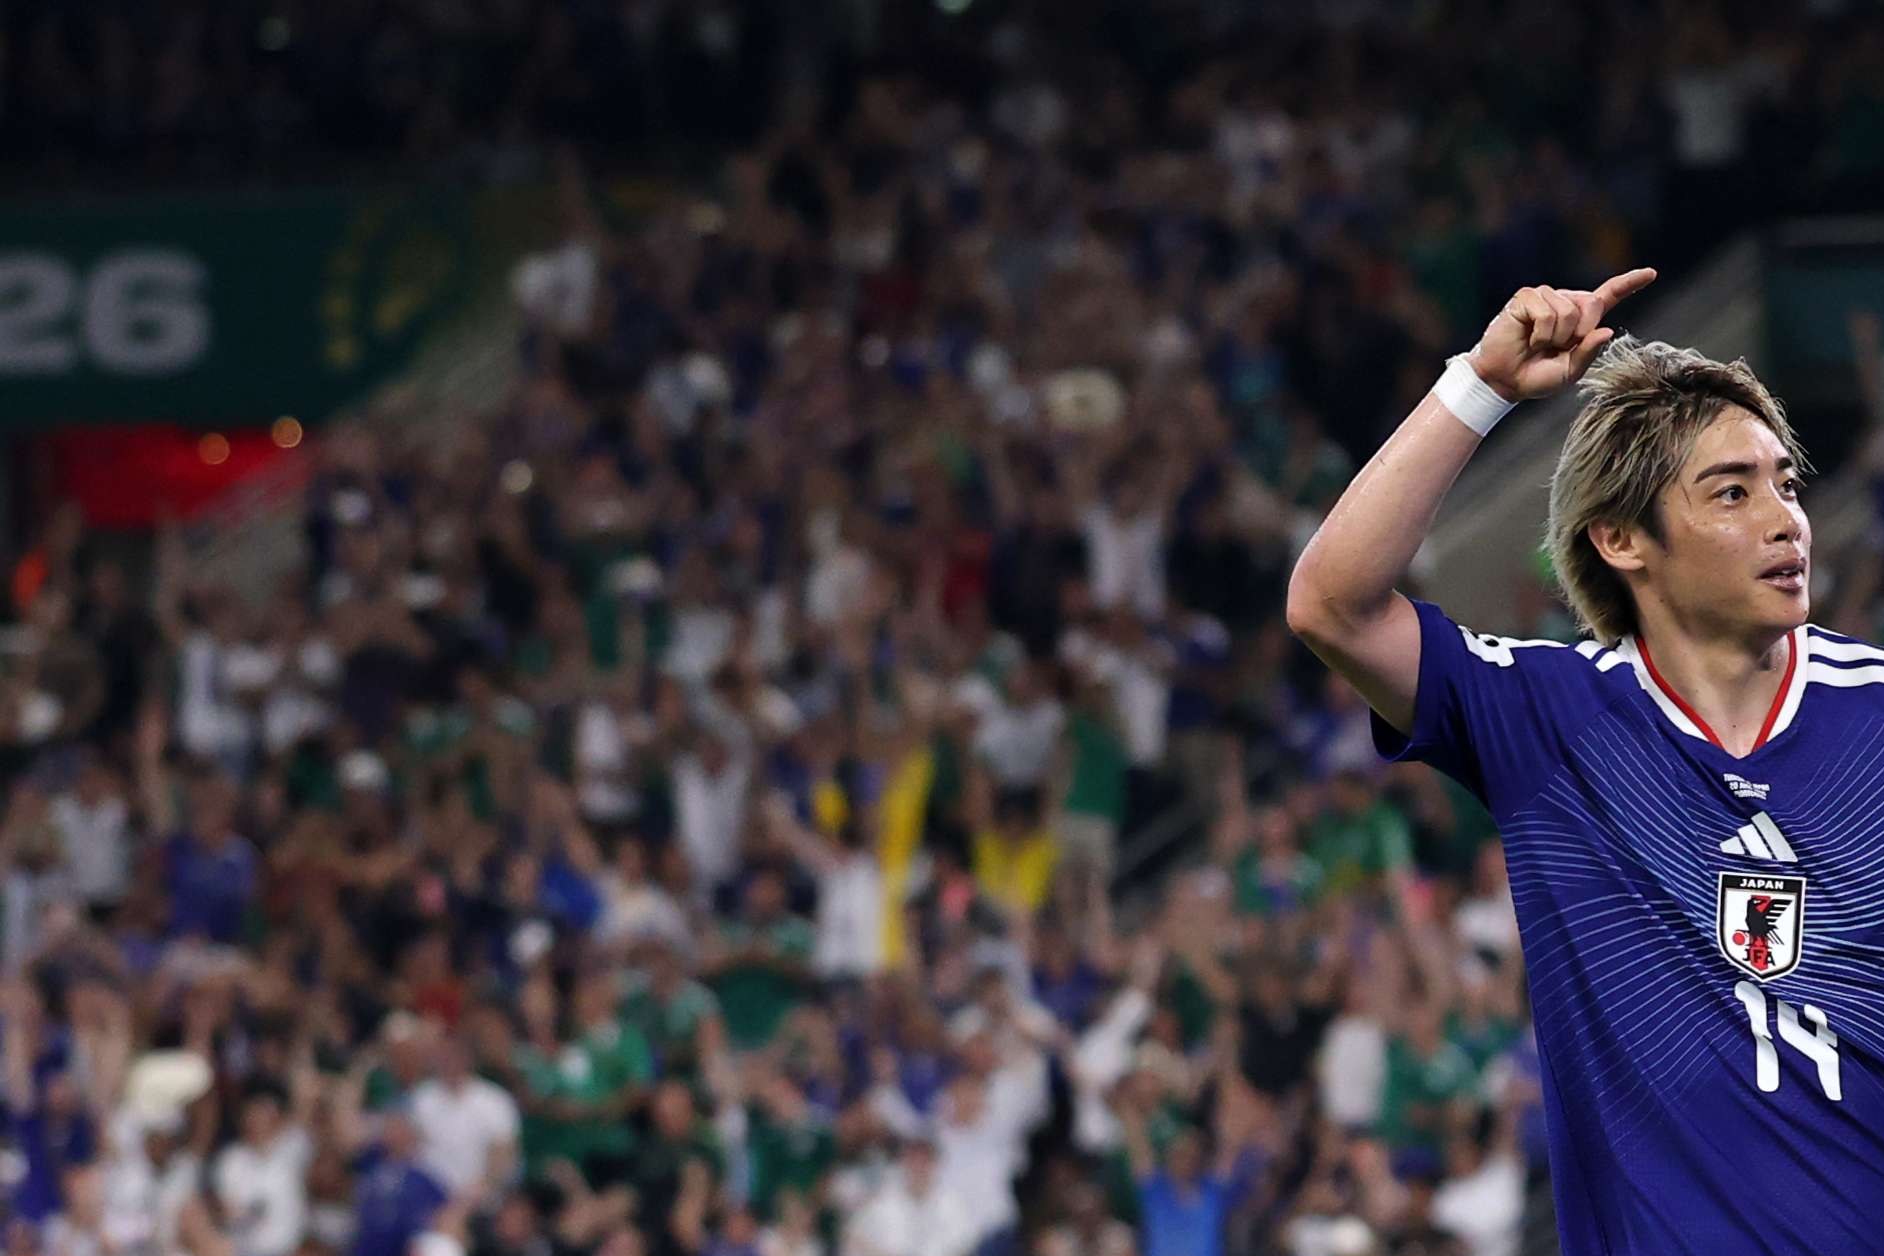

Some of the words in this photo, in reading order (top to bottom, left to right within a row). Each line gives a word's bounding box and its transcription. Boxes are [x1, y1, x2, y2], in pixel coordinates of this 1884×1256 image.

[0, 250, 212, 374] 26
[1740, 878, 1785, 890] JAPAN
[1742, 947, 1777, 967] JFA
[1734, 980, 1842, 1101] 14
